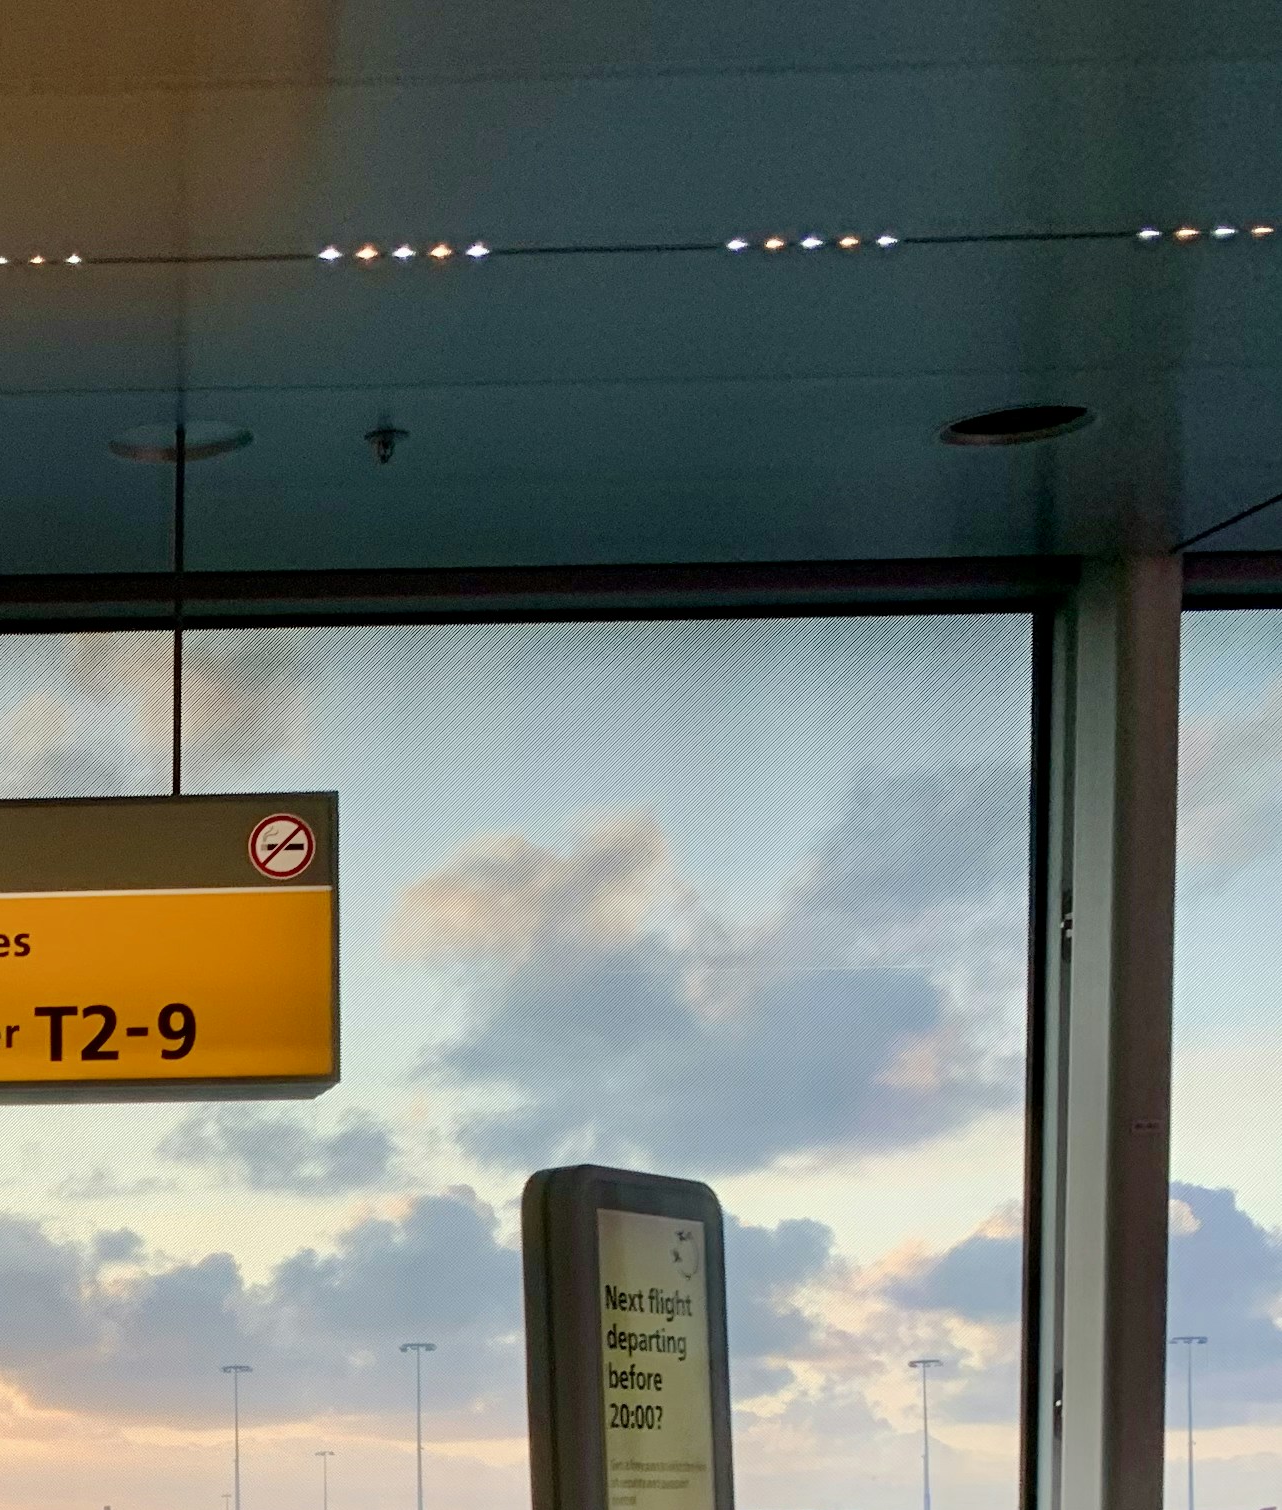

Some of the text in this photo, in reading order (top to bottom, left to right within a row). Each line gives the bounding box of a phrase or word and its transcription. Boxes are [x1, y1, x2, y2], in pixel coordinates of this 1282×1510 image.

[35, 1003, 197, 1062] T2-9
[605, 1284, 692, 1322] Next flight
[607, 1323, 687, 1362] departing
[609, 1362, 663, 1391] before
[610, 1402, 663, 1429] 20:00?
